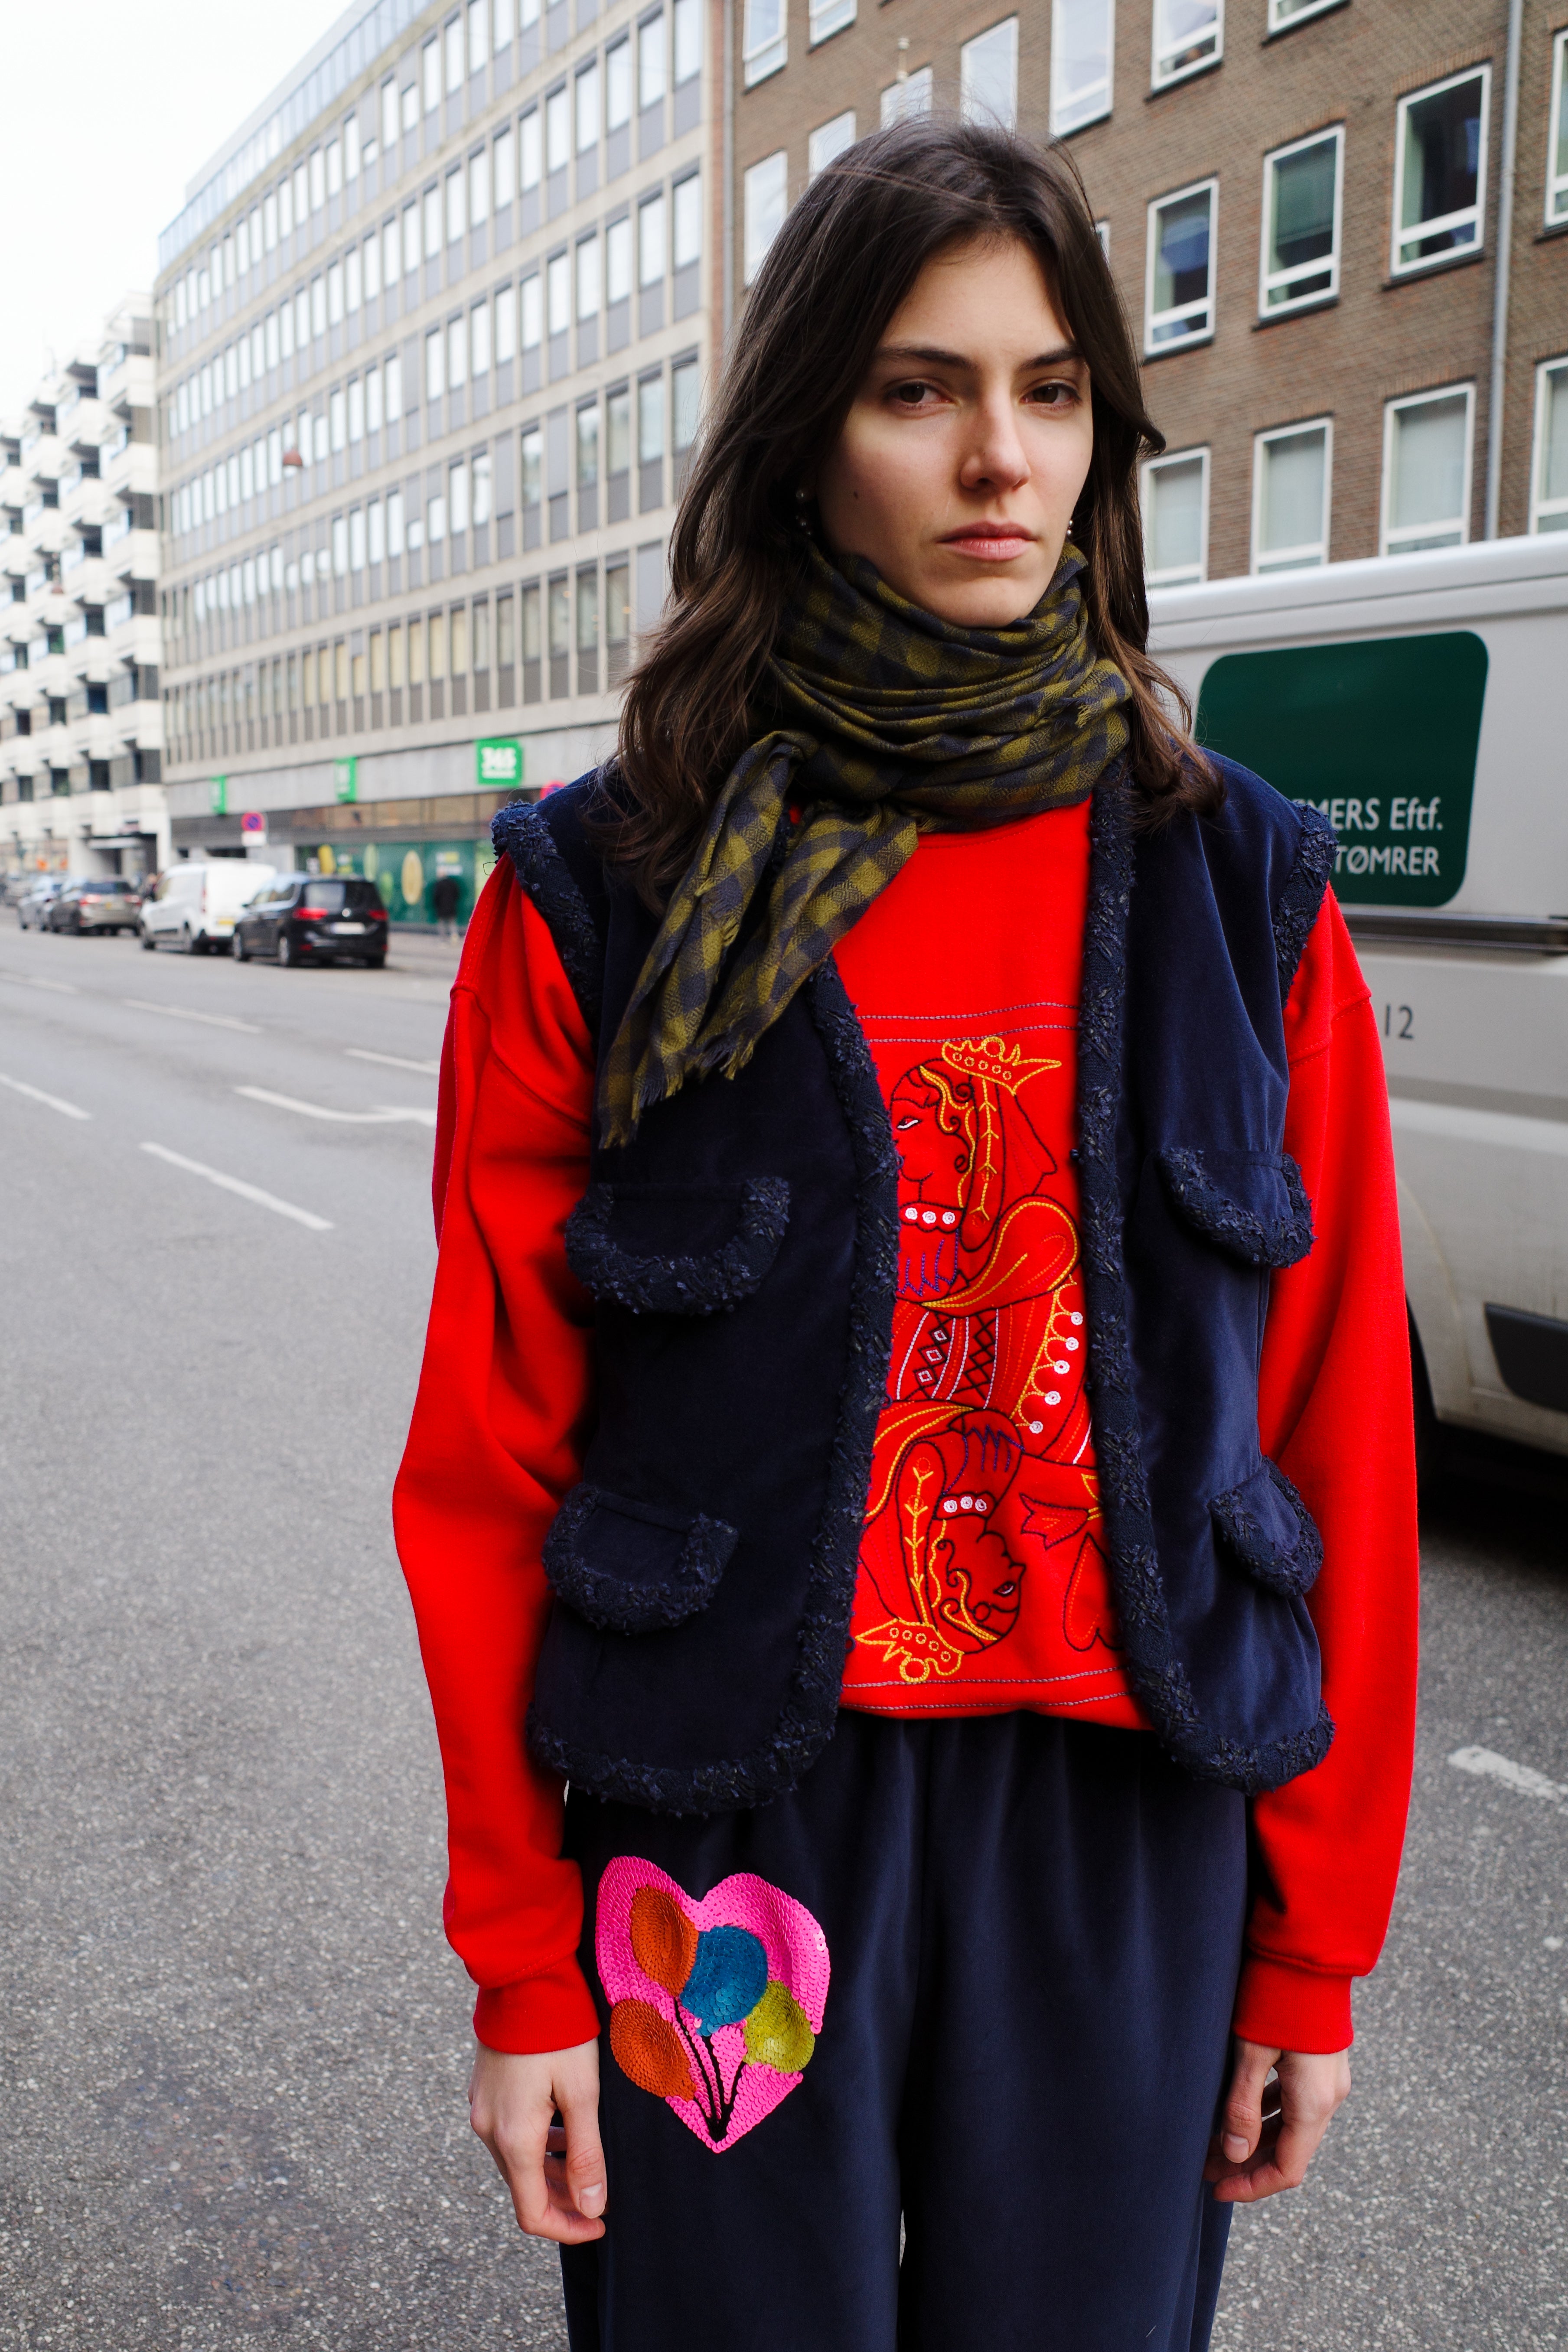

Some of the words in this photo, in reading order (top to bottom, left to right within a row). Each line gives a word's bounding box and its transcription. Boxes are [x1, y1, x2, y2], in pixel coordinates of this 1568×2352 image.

[1389, 796, 1443, 831] Eftf.
[1335, 845, 1441, 876] TØMRER
[1385, 1004, 1414, 1039] 12
